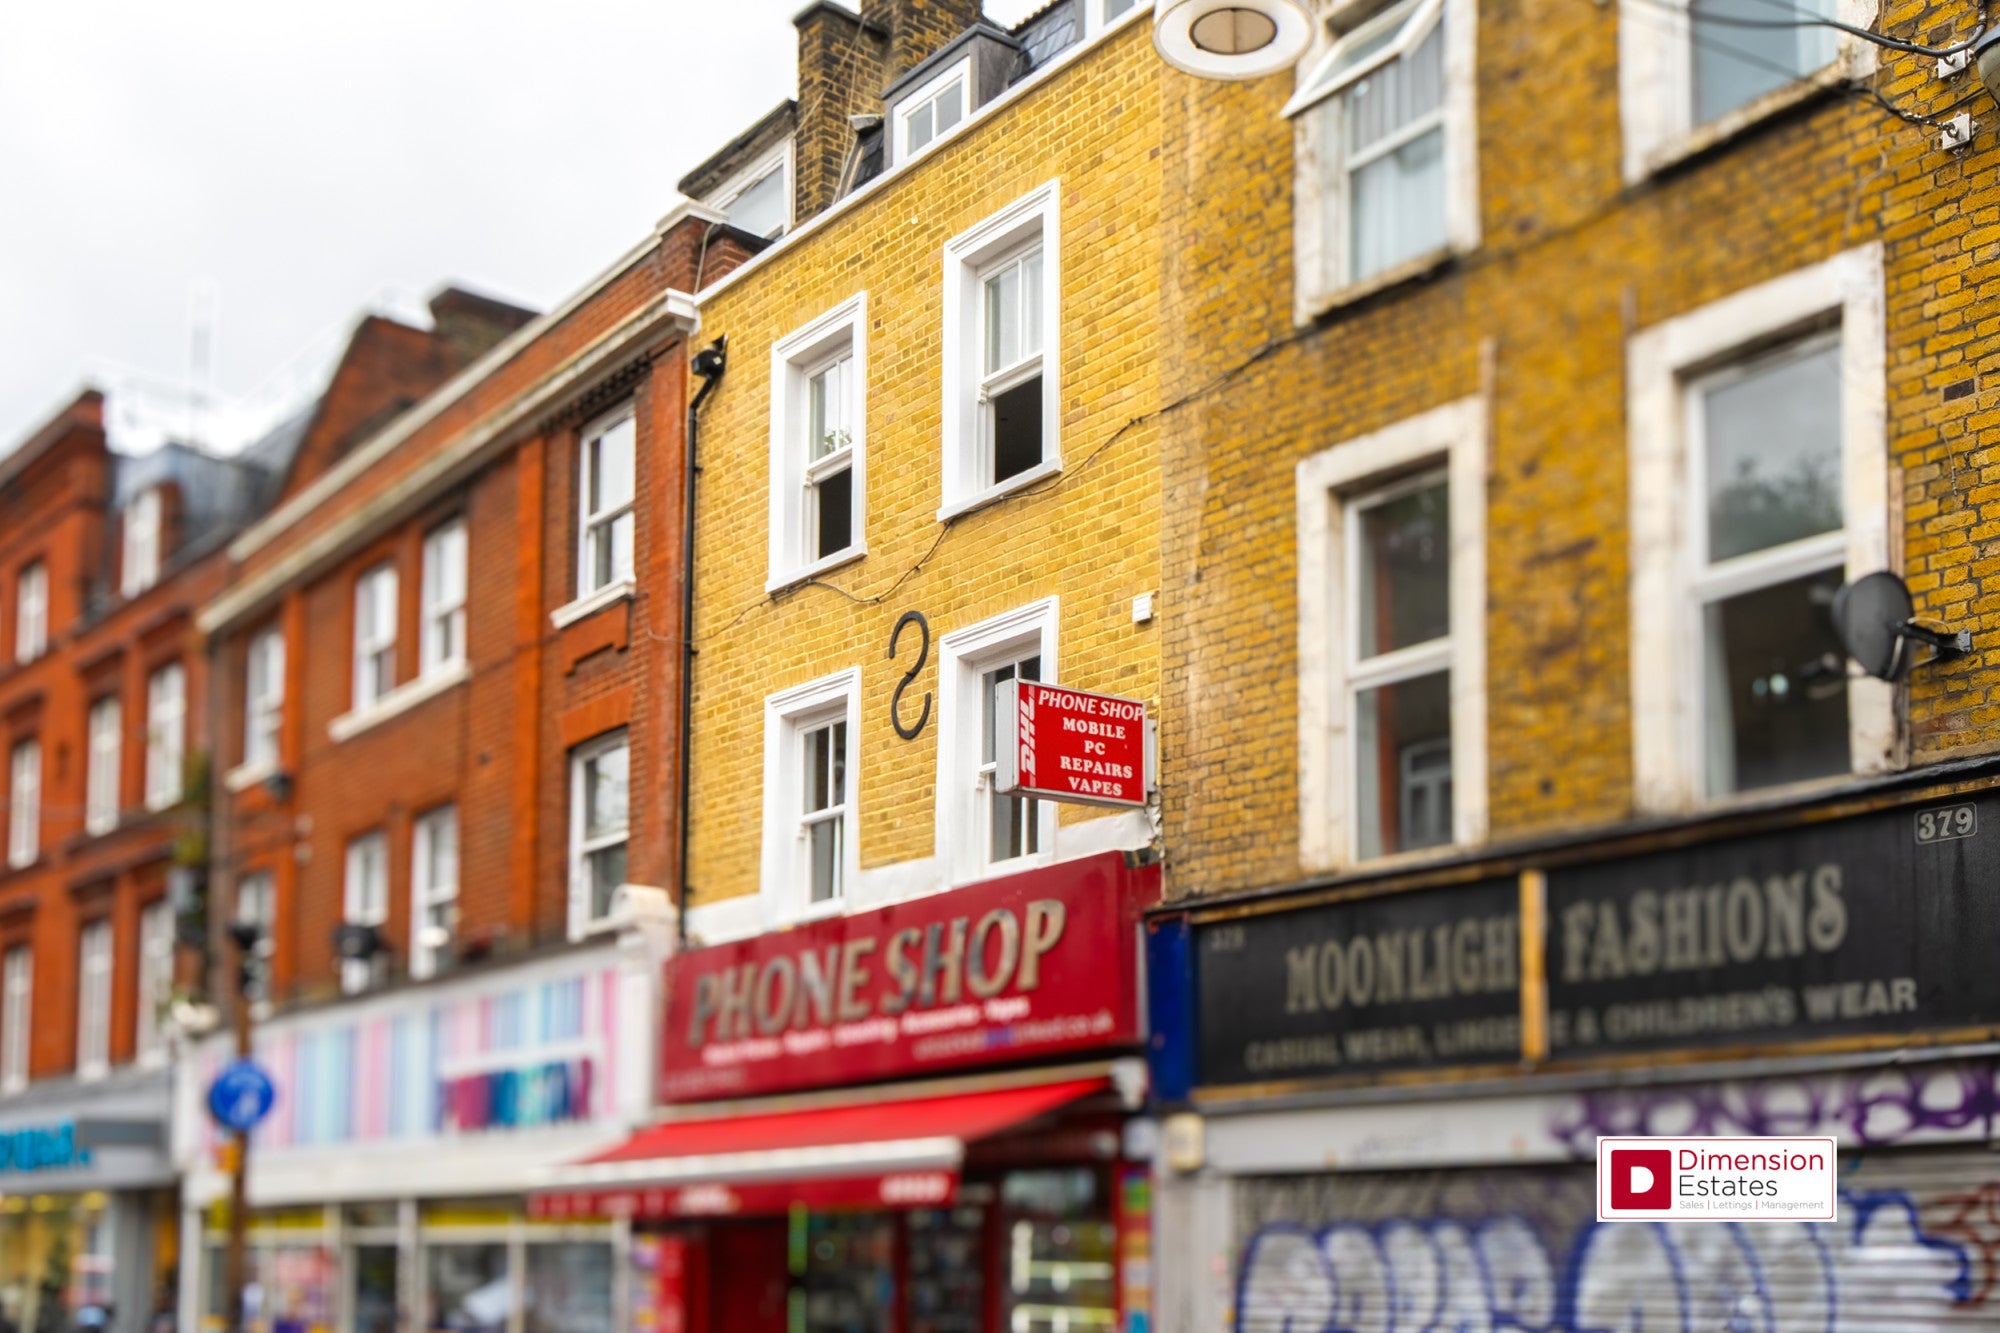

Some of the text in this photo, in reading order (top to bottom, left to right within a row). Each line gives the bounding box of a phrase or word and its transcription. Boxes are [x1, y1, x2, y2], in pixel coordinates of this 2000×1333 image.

[1038, 690, 1144, 721] PHONE SHOP
[1020, 696, 1036, 775] DHL
[1063, 717, 1126, 739] MOBILE
[1084, 740, 1106, 755] PC
[1060, 756, 1133, 779] REPAIRS
[1068, 776, 1122, 796] VAPES
[1919, 807, 1973, 840] 379
[1285, 864, 1847, 1016] MOONLIGH FASHIONS
[688, 938, 876, 1047] PHONE
[883, 898, 1067, 1012] SHOP
[1805, 978, 1918, 1020] WEAR
